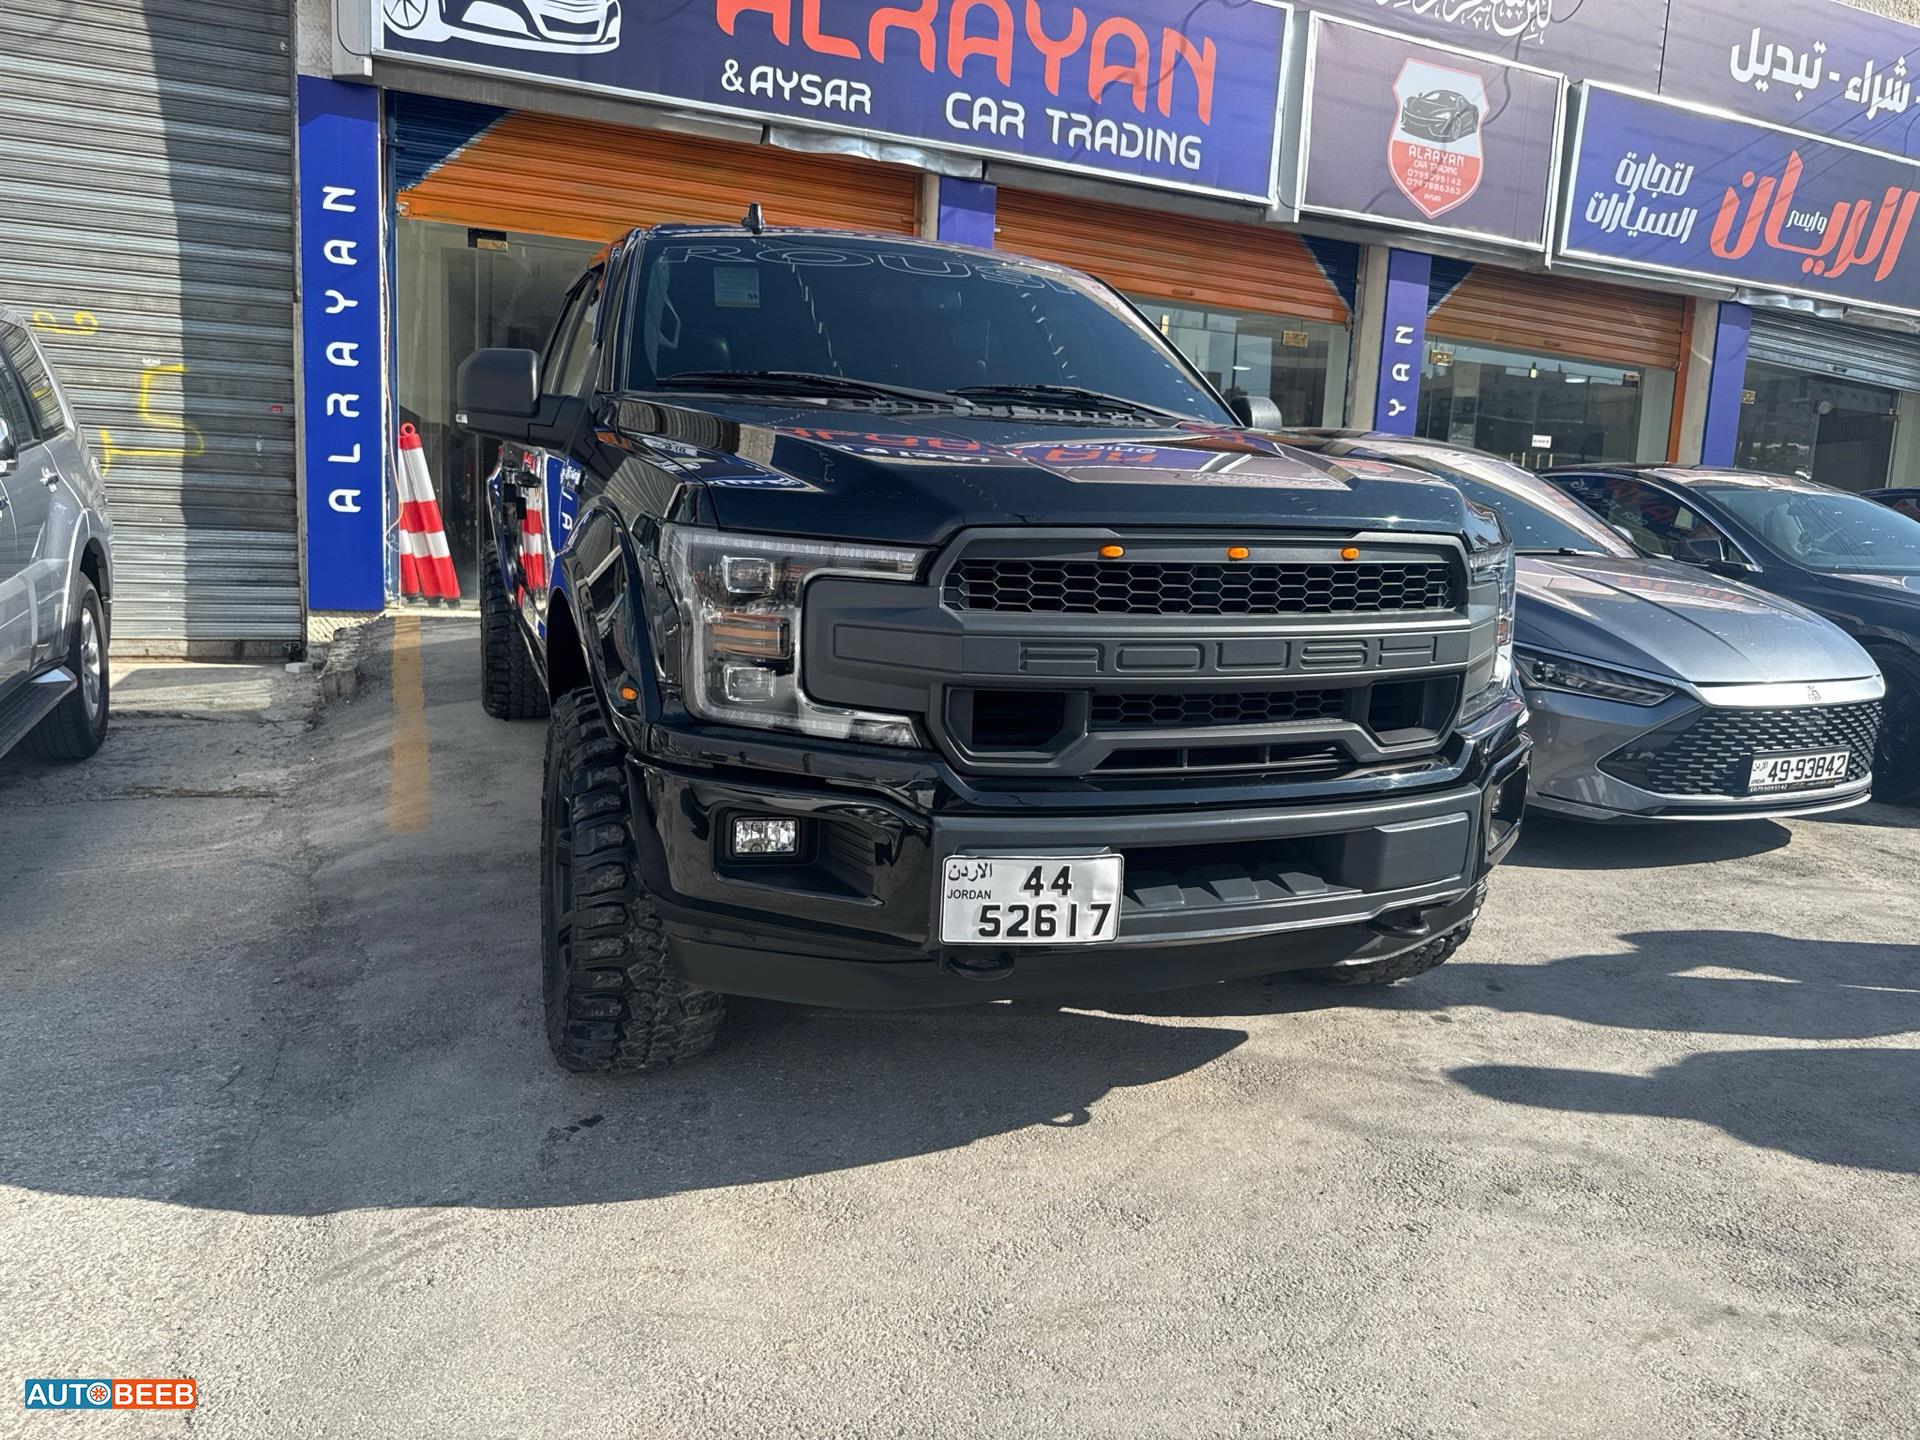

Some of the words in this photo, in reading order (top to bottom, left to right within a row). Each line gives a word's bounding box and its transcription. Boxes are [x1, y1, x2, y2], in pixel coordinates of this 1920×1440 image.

[1730, 27, 1827, 102] تبديل
[1844, 56, 1911, 121] شراء
[945, 91, 1026, 140] CAR
[1045, 107, 1202, 171] TRADING
[1408, 145, 1464, 167] ALRAYAN
[1413, 159, 1428, 169] CAR
[1407, 168, 1462, 187] 0795095142
[1615, 151, 1695, 199] لتجارة
[1585, 191, 1698, 244] السيارات
[1710, 149, 1920, 282] الريان
[322, 186, 361, 513] ALRAYAN
[1018, 635, 1438, 673] ROUSH
[1768, 754, 1847, 783] 49-93842
[948, 862, 993, 882] الاردن
[1023, 865, 1073, 897] 44
[947, 889, 992, 900] JORDAN
[978, 903, 1112, 938] 52617
